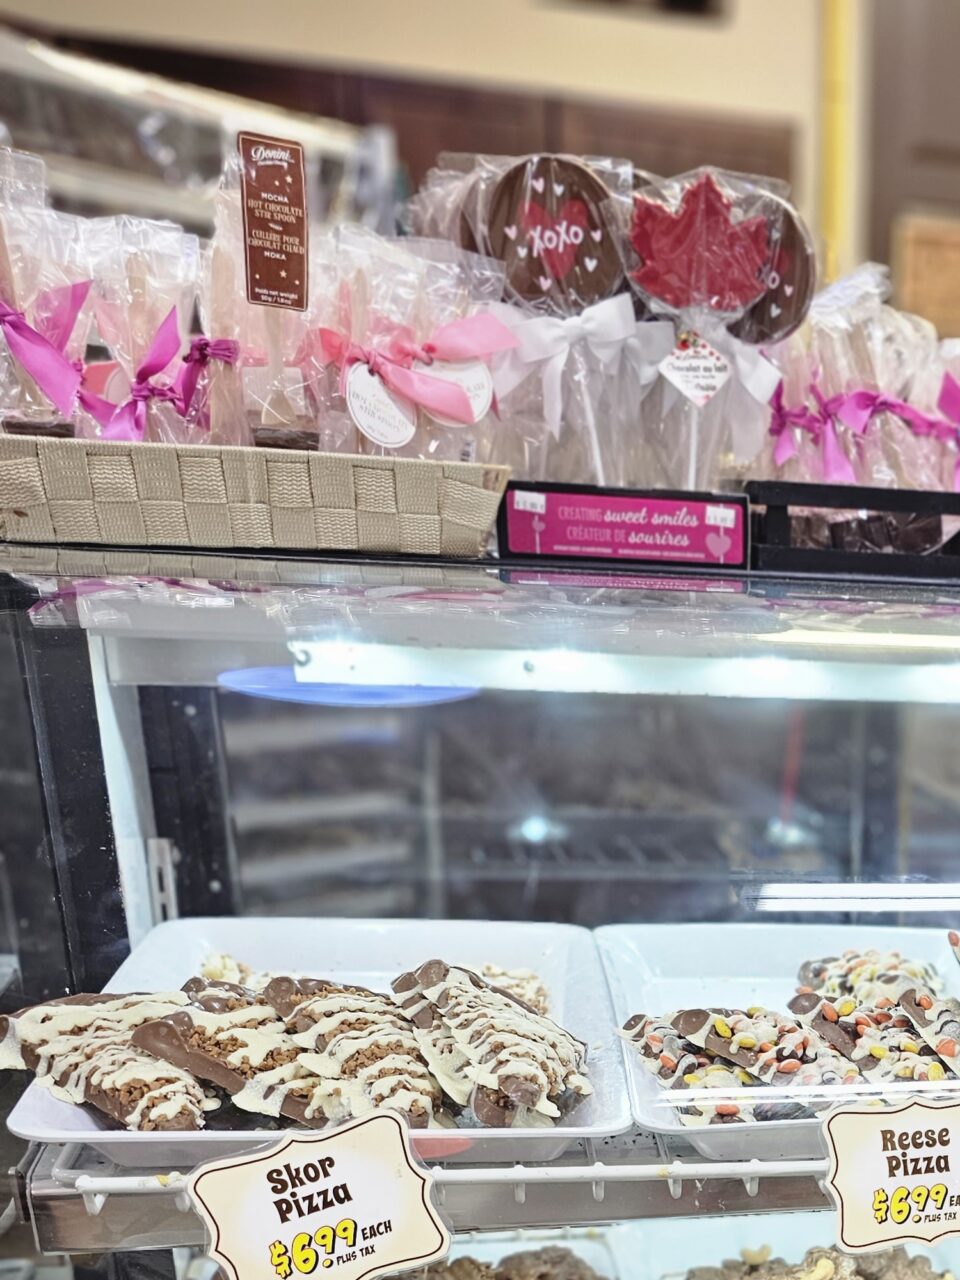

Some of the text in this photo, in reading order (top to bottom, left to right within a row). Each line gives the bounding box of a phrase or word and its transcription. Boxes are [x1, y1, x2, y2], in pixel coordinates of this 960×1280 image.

[251, 145, 290, 161] Donini
[261, 191, 289, 203] MOCHA
[248, 199, 304, 217] HOT CHOCOLATE
[254, 209, 297, 224] STIR SPOON
[248, 237, 305, 255] CHOCOLAT CHAUD
[283, 235, 300, 245] POUR
[530, 221, 584, 258] XOXO
[264, 251, 287, 260] MOKA
[558, 506, 603, 523] CREATING
[603, 507, 648, 525] sweet
[651, 507, 699, 528] smiles
[613, 527, 626, 541] DE
[628, 530, 690, 547] sourires
[880, 1127, 950, 1152] Reese
[266, 1156, 335, 1195] Skor
[886, 1152, 950, 1178] Pizza
[273, 1182, 353, 1224] Pizza
[872, 1183, 948, 1224] $6.99
[924, 1212, 957, 1223] PLUS TAX
[268, 1218, 393, 1280] $6.99 EACH
[336, 1244, 376, 1266] PLUS TAX
